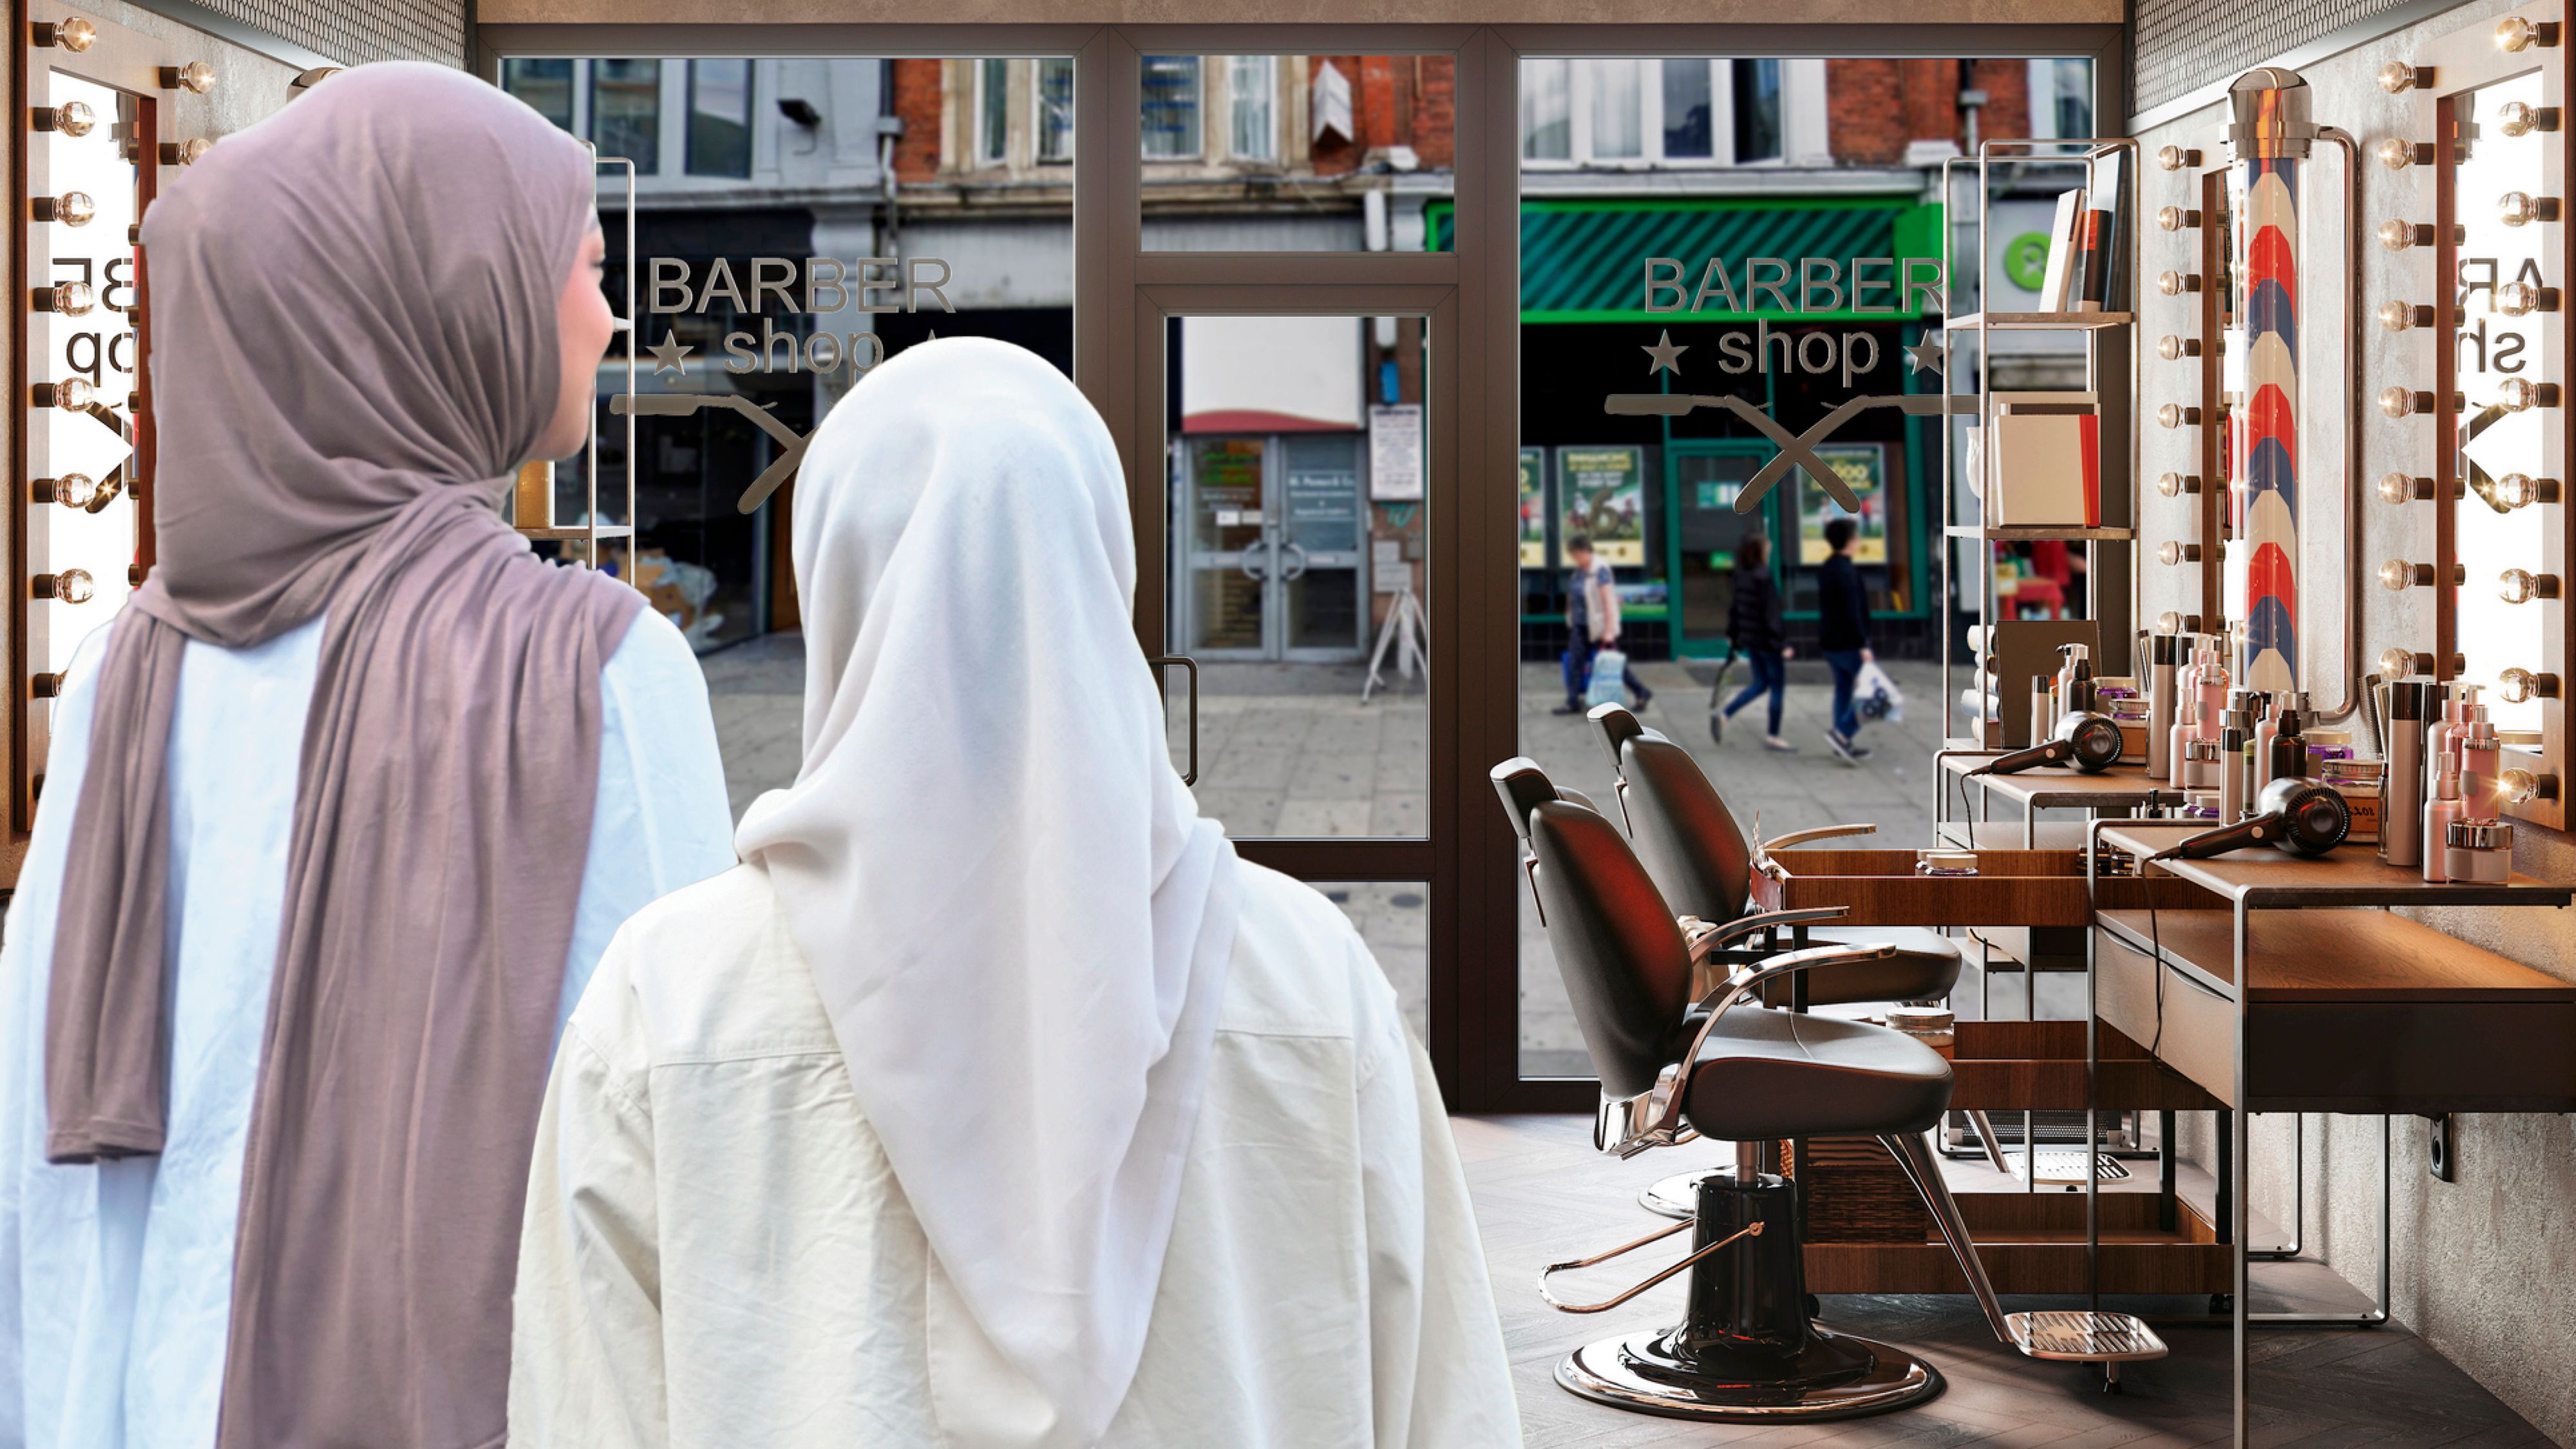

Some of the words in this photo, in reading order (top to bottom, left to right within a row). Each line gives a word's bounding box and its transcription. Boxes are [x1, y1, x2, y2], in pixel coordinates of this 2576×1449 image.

[649, 258, 956, 314] BARBER
[1644, 258, 1945, 314] BARBER
[723, 317, 884, 388] shop
[1718, 317, 1880, 388] shop
